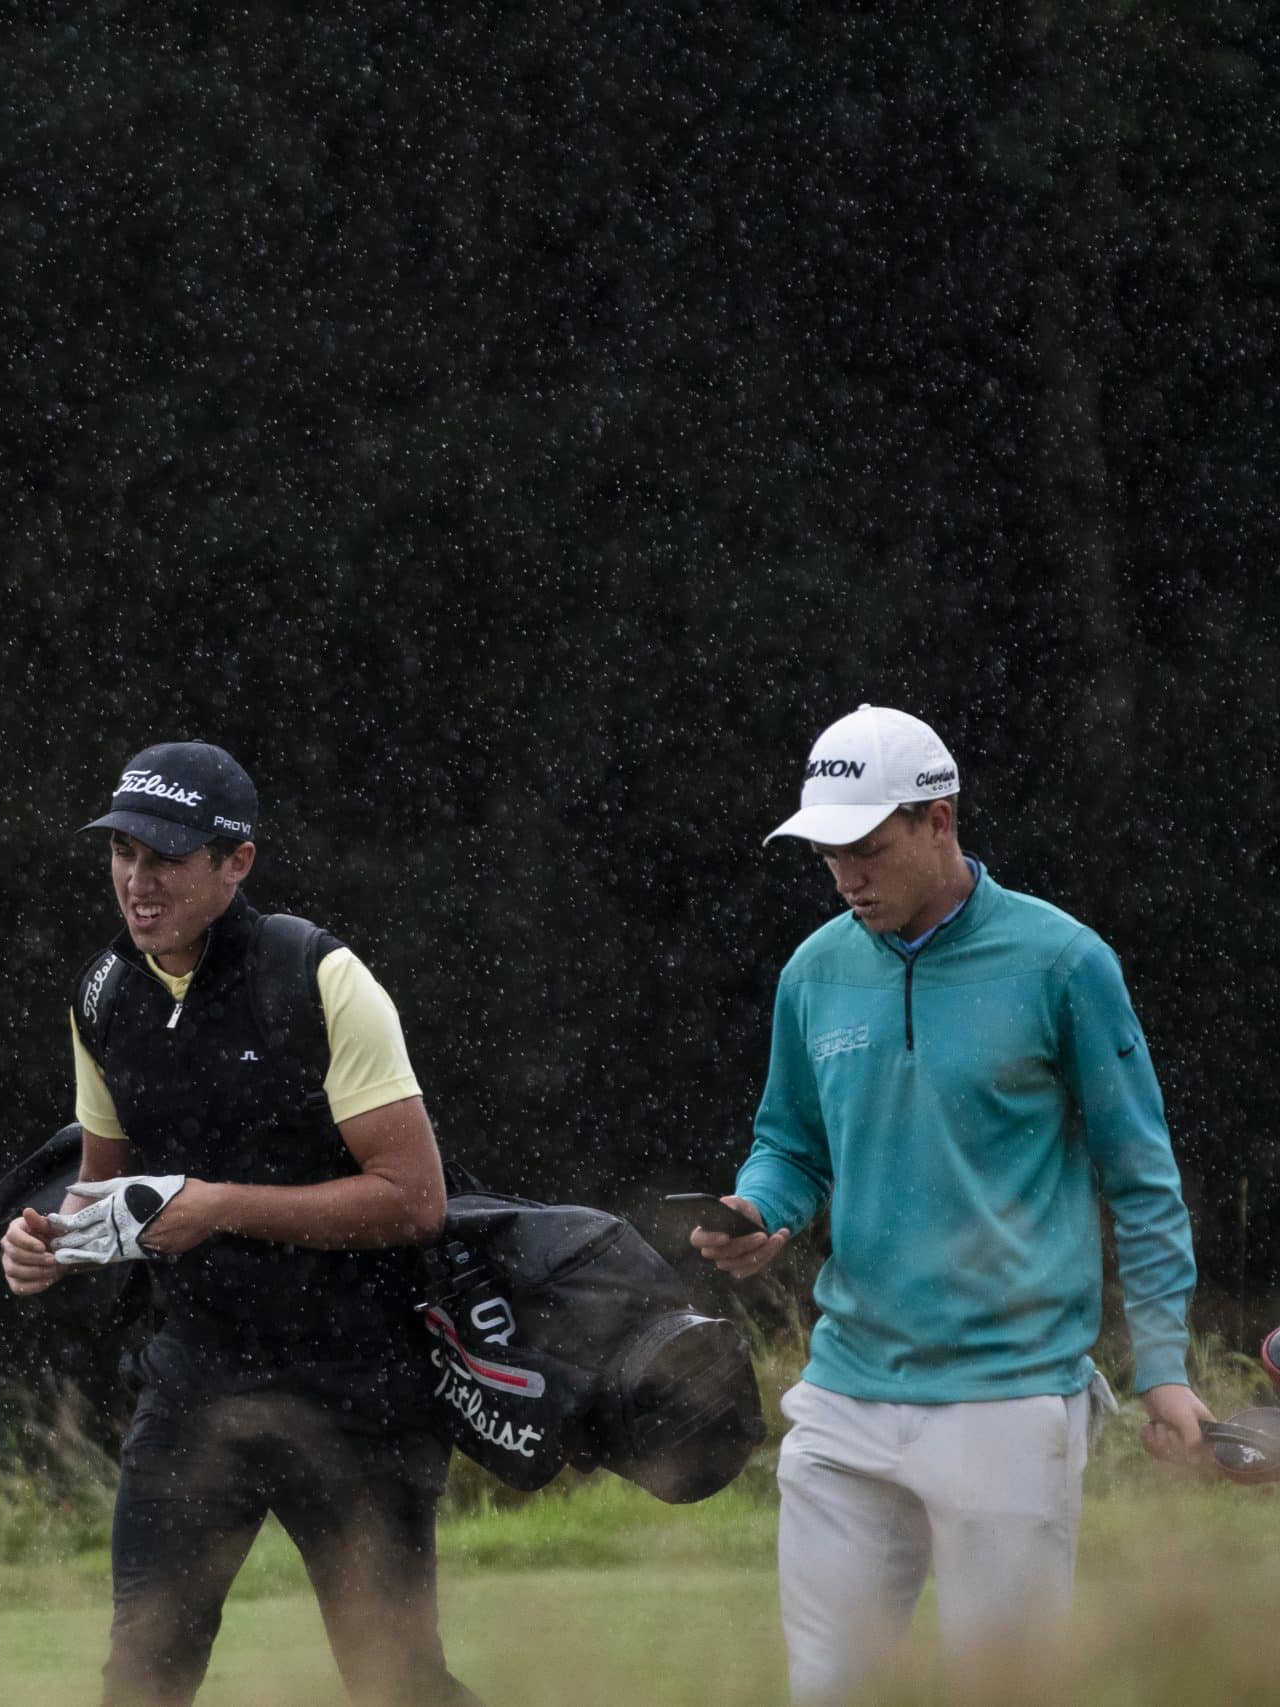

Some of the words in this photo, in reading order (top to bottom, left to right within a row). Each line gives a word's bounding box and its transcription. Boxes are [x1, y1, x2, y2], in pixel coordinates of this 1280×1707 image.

[112, 770, 202, 807] Titleist
[807, 759, 866, 779] IXON
[83, 953, 117, 1024] Titlei
[430, 1347, 543, 1458] Titleist
